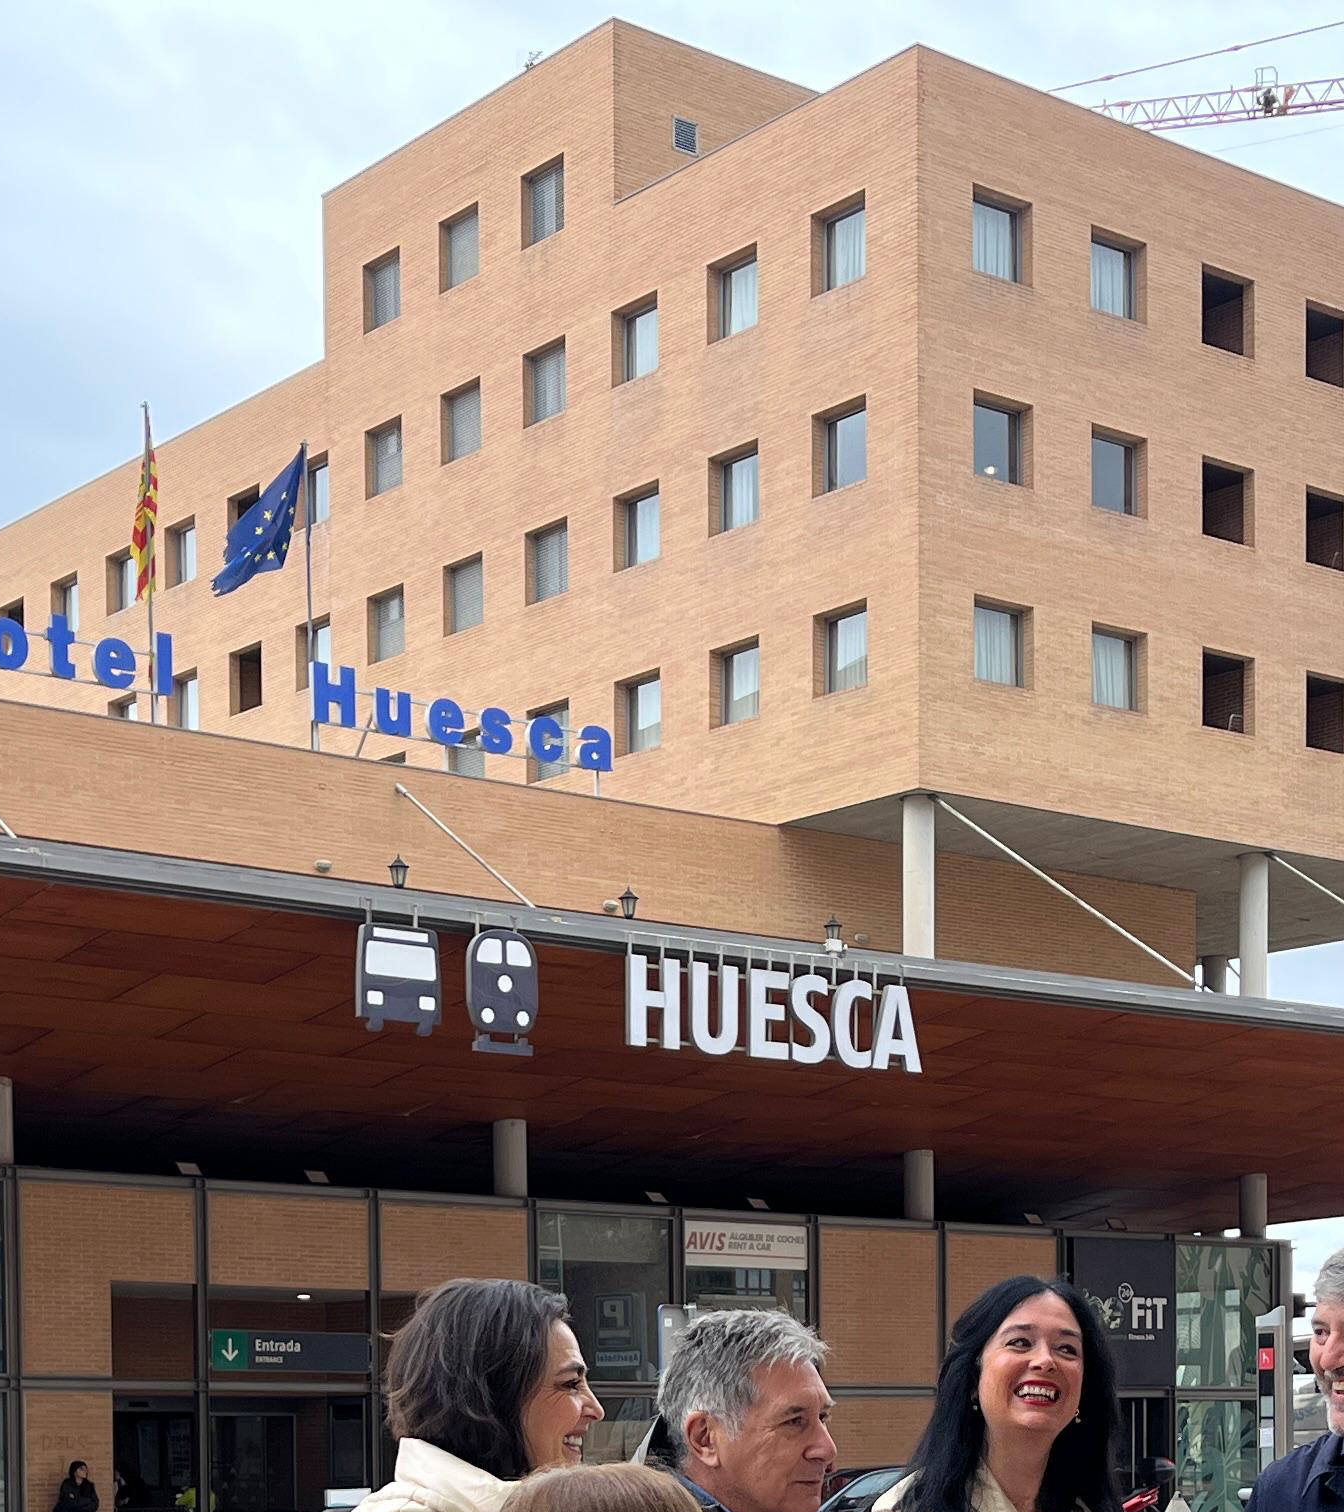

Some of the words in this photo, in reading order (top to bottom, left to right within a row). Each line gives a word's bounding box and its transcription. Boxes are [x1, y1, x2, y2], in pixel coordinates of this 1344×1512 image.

[309, 661, 614, 771] Huesca
[626, 953, 923, 1074] HUESCA
[686, 1231, 727, 1251] AVIS
[728, 1241, 748, 1250] RENT
[748, 1242, 755, 1251] A
[756, 1242, 772, 1251] CAR
[729, 1232, 764, 1242] ALQUILER
[765, 1234, 775, 1243] DE
[776, 1234, 805, 1245] COCHES
[1131, 1296, 1168, 1330] FiT
[255, 1339, 301, 1353] Entrada
